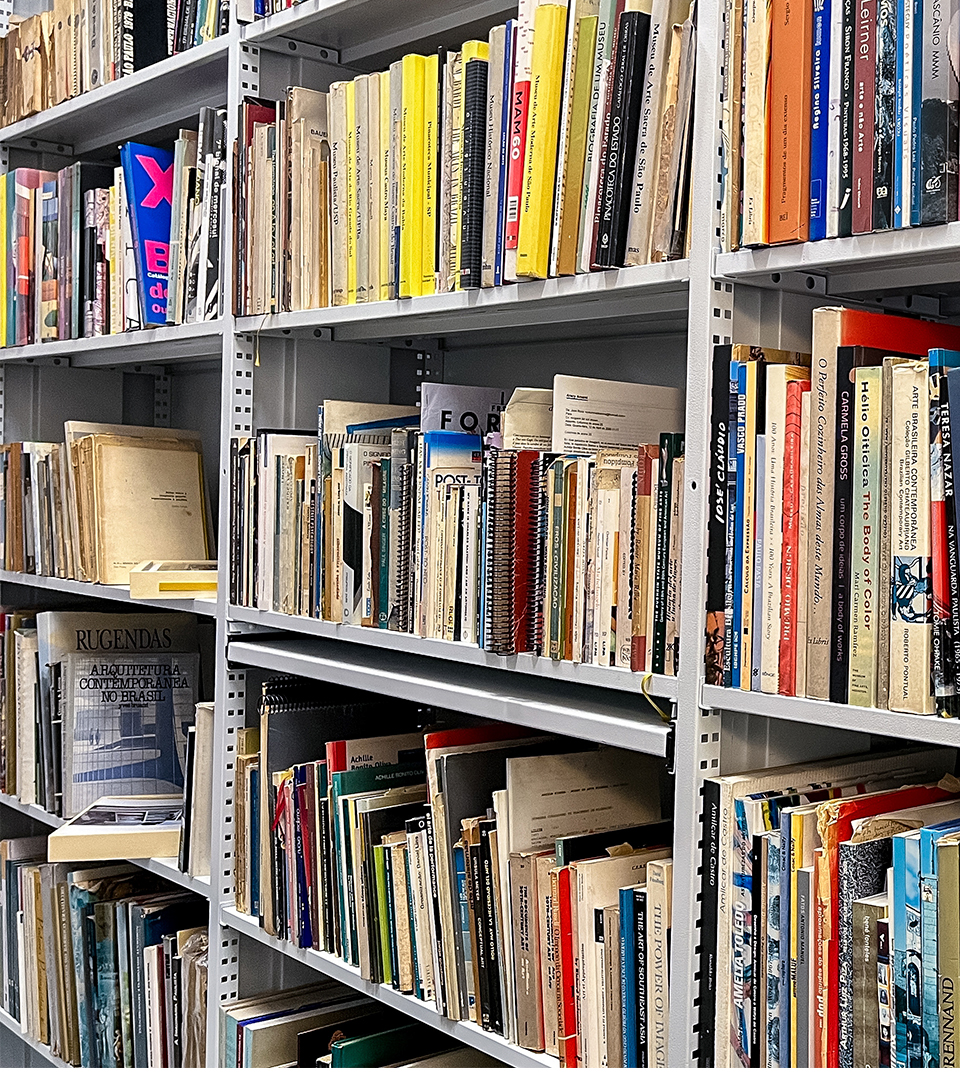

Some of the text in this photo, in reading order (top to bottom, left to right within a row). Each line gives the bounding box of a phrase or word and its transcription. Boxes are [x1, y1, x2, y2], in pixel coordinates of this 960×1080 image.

[597, 21, 606, 60] MUSEU
[858, 0, 870, 61] Leirner
[812, 49, 821, 130] Regina Silveira
[931, 51, 940, 80] MMM
[633, 23, 660, 214] Museu de Arte Sacra de São Paulo
[603, 116, 621, 221] PINACOTECA DO ESTADO
[715, 421, 727, 482] CLÁUDIO
[736, 394, 746, 455] VASCO PRADO
[839, 391, 849, 481] CARMELA GROSS
[940, 402, 954, 497] TERESA NAZAR
[814, 371, 828, 562] Perfeito Cozinheiro Almas deste
[860, 381, 873, 631] Hélio Oiticica The Body of Color
[784, 545, 793, 589] DESIGN
[75, 628, 173, 650] RUGENDAS
[78, 677, 190, 690] CONTEMPORÂNEA
[89, 664, 181, 679] ARQUITETURA
[101, 690, 166, 703] NO BRASIL
[654, 939, 663, 993] POWER
[733, 901, 745, 1010] AMELIA TOLEDO
